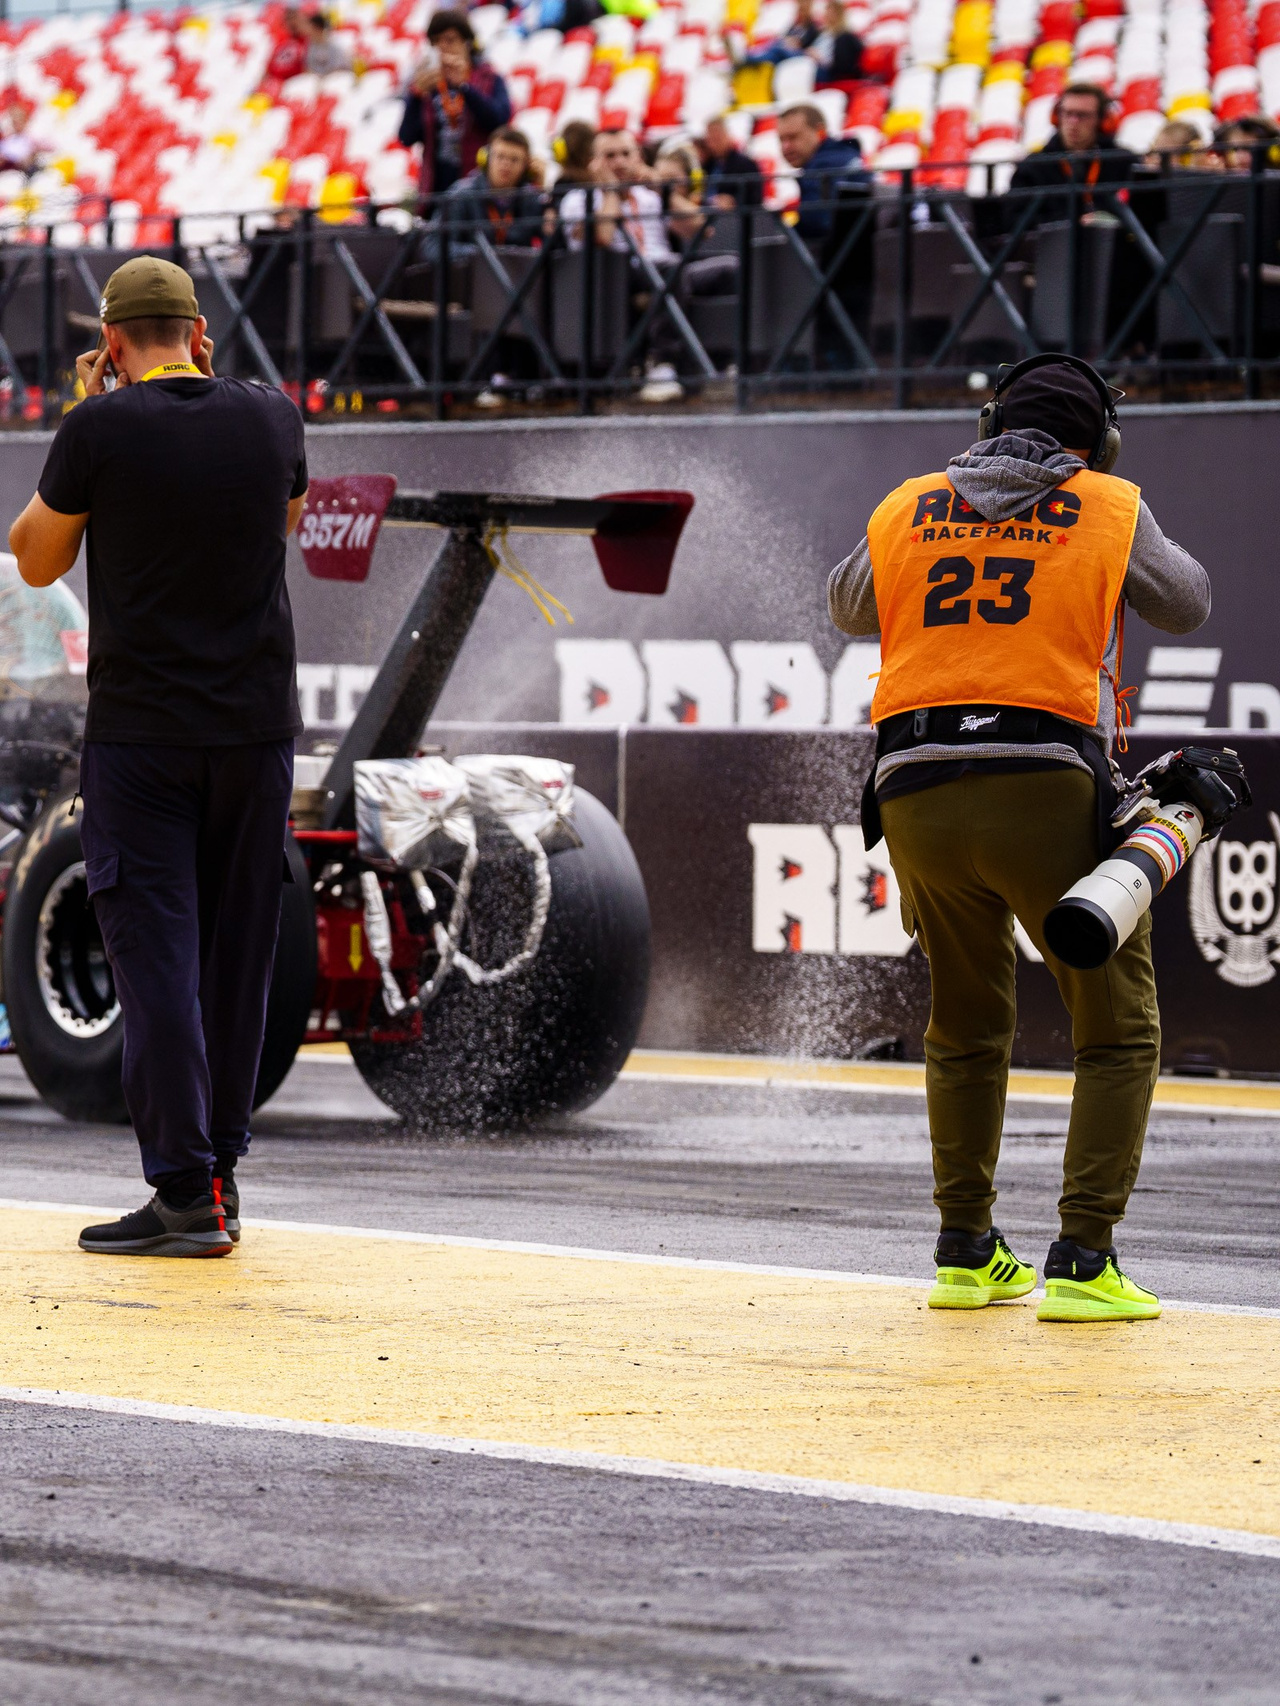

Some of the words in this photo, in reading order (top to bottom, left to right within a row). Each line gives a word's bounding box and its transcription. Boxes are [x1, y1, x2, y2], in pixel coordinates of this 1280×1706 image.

[300, 513, 376, 549] 357M
[922, 526, 1053, 544] RACEPARK
[923, 555, 1036, 628] 23
